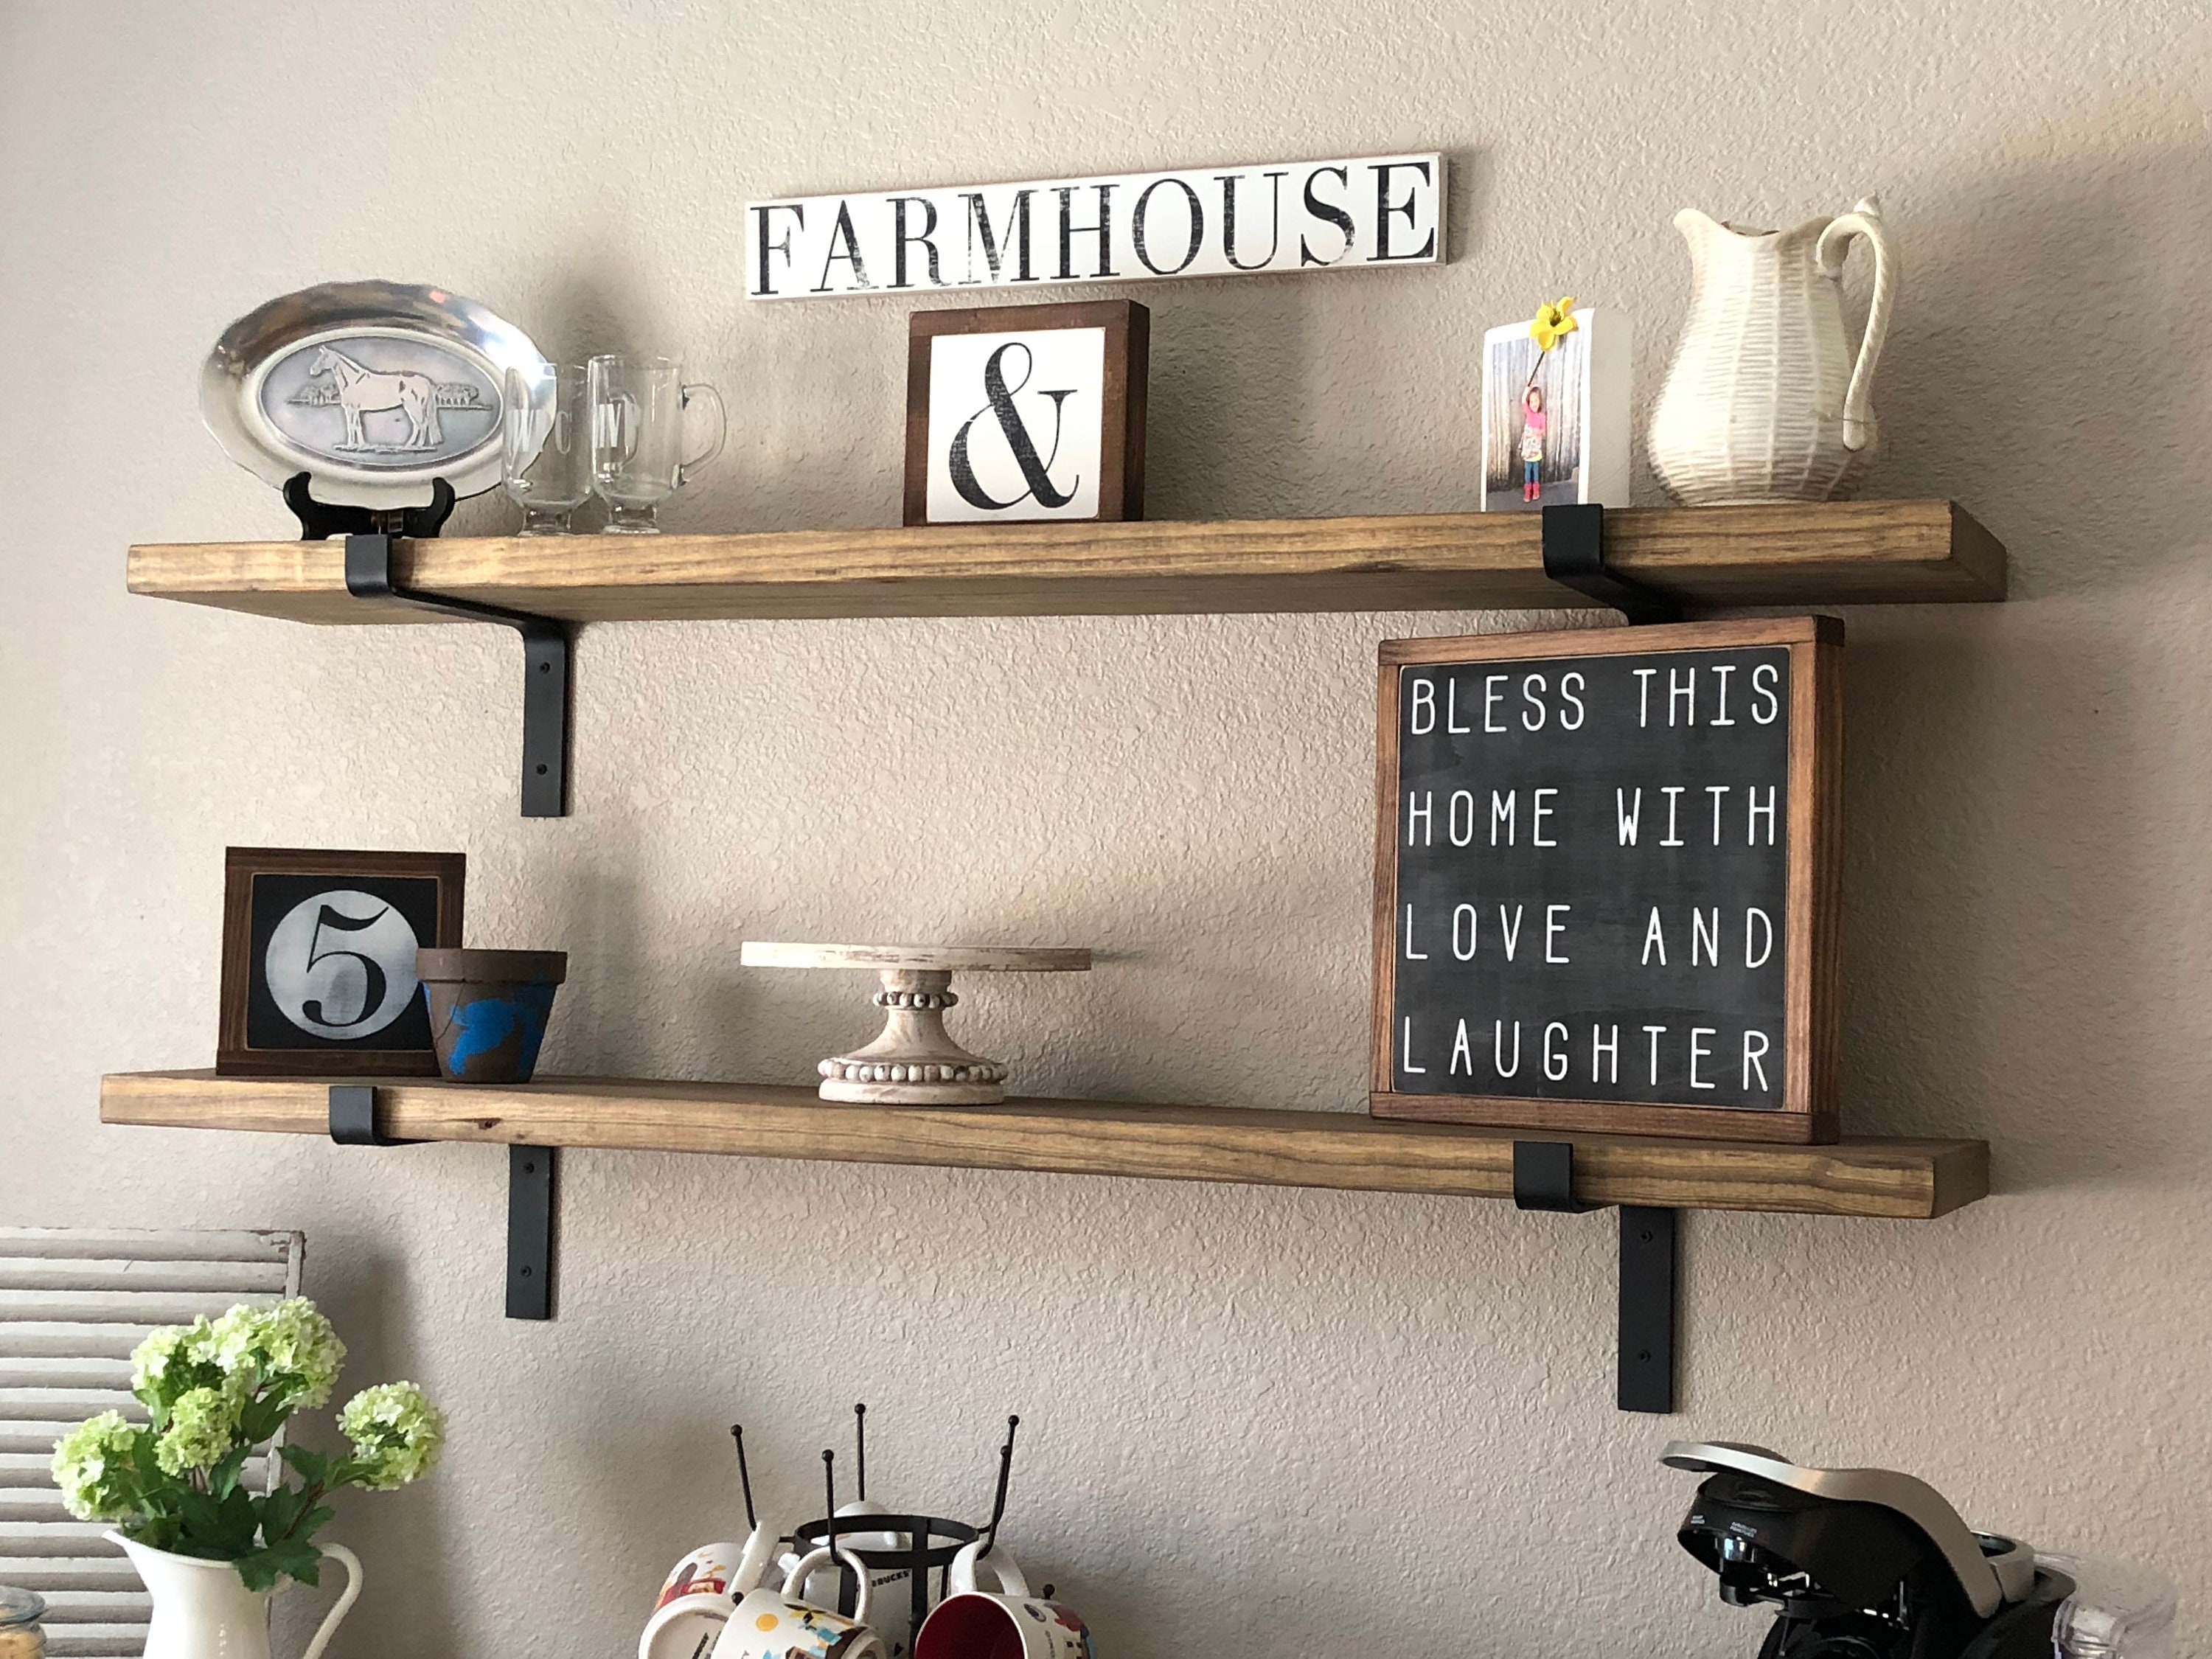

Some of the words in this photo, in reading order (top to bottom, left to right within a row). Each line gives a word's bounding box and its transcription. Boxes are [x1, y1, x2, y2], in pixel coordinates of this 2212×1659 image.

[749, 161, 1435, 296] FARMHOUSE
[948, 341, 1079, 510] &
[1411, 672, 1585, 735] BLESS
[1632, 664, 1779, 728] THIS
[1408, 788, 1558, 847] HOME
[1616, 785, 1775, 846] WITH
[302, 904, 389, 1027] 5
[1405, 902, 1571, 964] LOVE
[1641, 906, 1773, 968] AND
[1403, 1015, 1770, 1092] LAUGHTER
